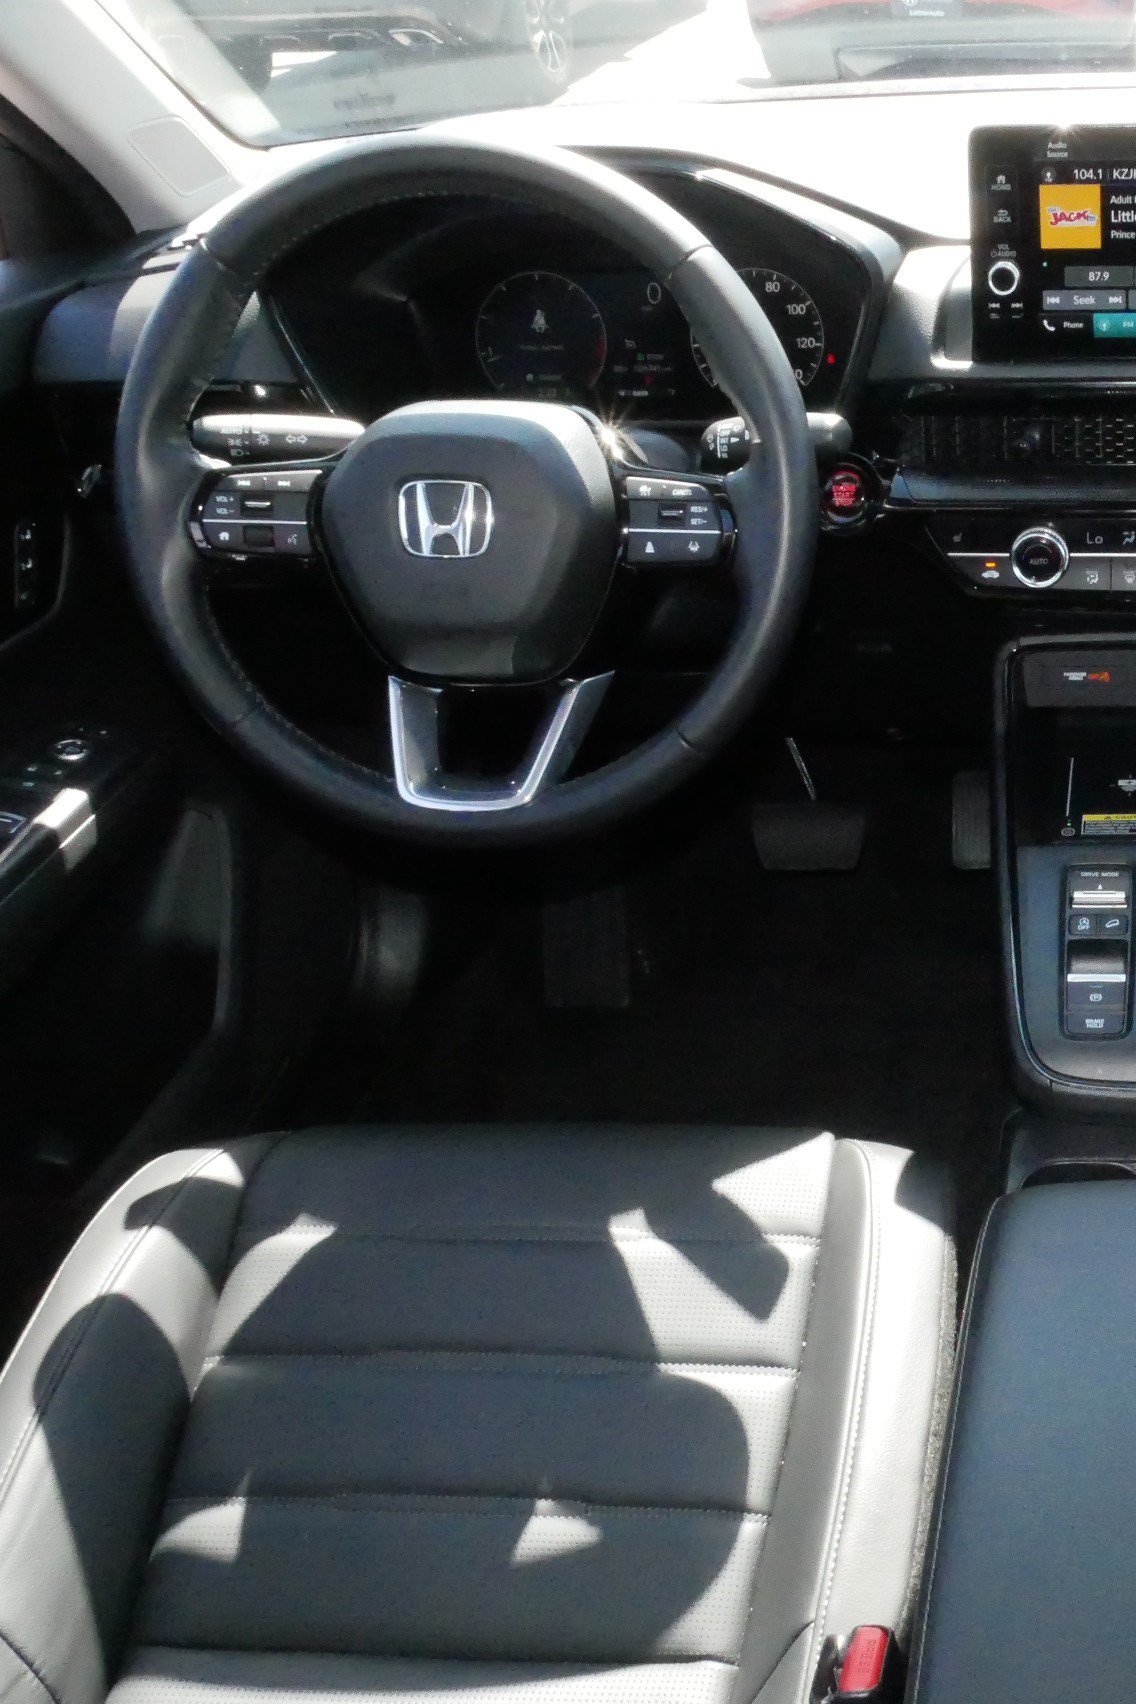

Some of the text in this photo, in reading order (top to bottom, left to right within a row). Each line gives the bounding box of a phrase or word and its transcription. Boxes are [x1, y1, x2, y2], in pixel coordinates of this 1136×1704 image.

[1047, 141, 1067, 149] Audio
[1046, 150, 1068, 158] Source
[1073, 168, 1103, 180] 104.1
[1110, 195, 1132, 204] Adult
[1050, 210, 1090, 226] JACK
[1110, 230, 1136, 239] Prince
[1088, 271, 1110, 281] 87.9
[765, 281, 780, 293] 80
[646, 282, 662, 304] 0
[1073, 294, 1096, 305] Seek
[786, 303, 806, 315] 100
[1063, 321, 1084, 329] Phone
[797, 337, 816, 349] 120
[1086, 532, 1104, 545] Lo
[1029, 558, 1049, 566] AUTO
